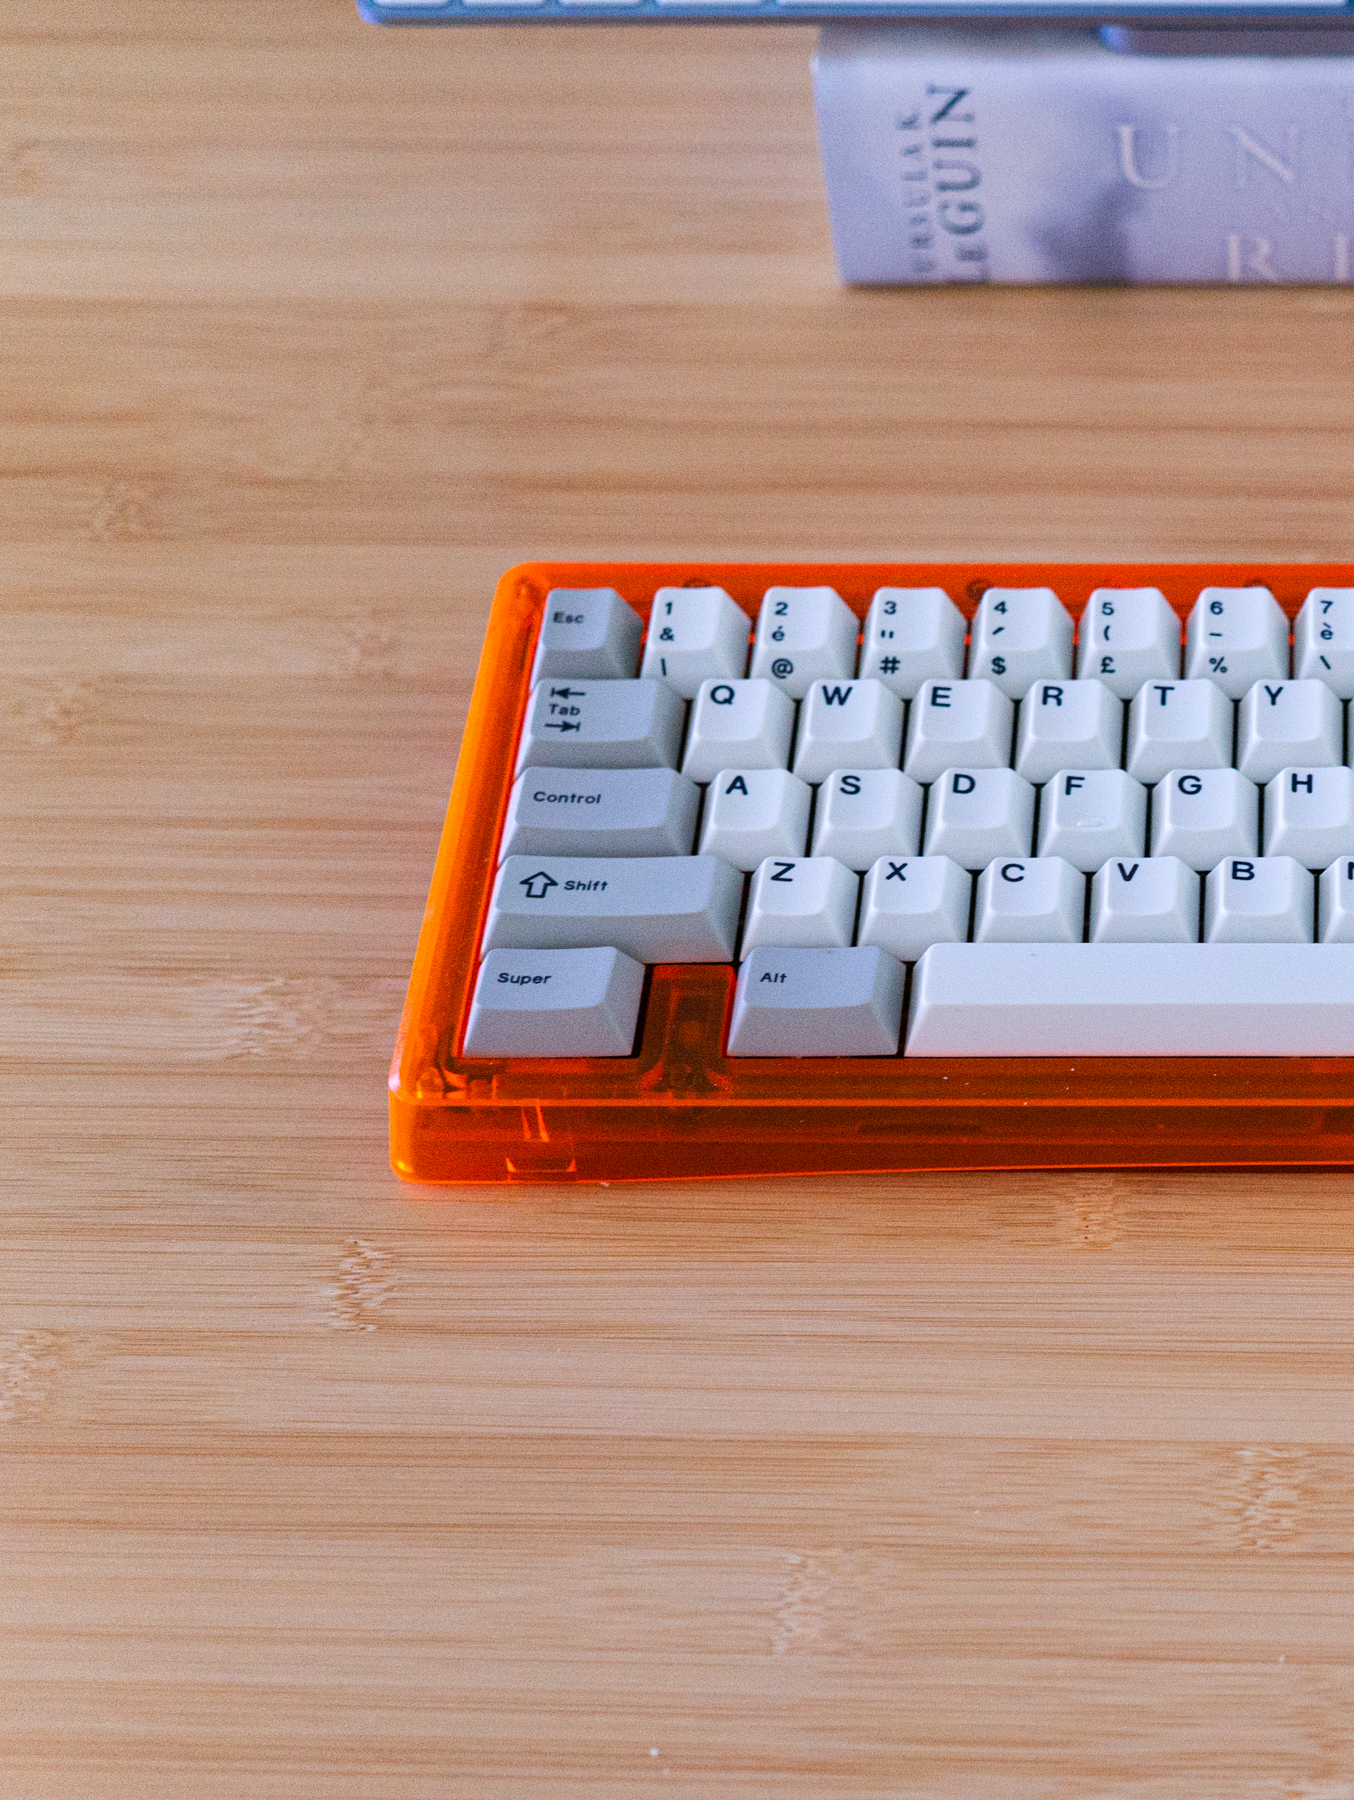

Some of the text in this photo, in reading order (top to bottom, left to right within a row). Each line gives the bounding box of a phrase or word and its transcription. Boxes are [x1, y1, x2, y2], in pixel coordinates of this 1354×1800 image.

[775, 602, 788, 616] 2
[884, 601, 897, 615] 3
[994, 601, 1007, 614] 4
[1102, 602, 1114, 616] 5
[1210, 601, 1223, 615] 6
[1321, 600, 1333, 614] 7
[553, 611, 583, 623] Esc
[659, 627, 674, 641] &
[771, 626, 785, 641] é
[1320, 623, 1333, 640] è
[771, 658, 794, 679] @
[880, 657, 900, 674] #
[992, 656, 1006, 675] $
[1101, 656, 1115, 674] £
[1209, 657, 1228, 673] %
[710, 685, 735, 705] Q
[822, 686, 852, 706] W
[931, 686, 951, 707] E
[1042, 686, 1063, 706] R
[1154, 686, 1174, 706] T
[1265, 685, 1283, 706] Y
[549, 703, 580, 716] Tab
[726, 776, 748, 795] A
[840, 775, 860, 795] S
[953, 774, 975, 794] D
[1065, 776, 1084, 795] F
[1178, 775, 1202, 795] G
[1291, 773, 1313, 793] H
[533, 791, 601, 804] Control
[771, 862, 795, 882] Z
[886, 862, 907, 881] X
[1001, 864, 1024, 882] C
[1118, 863, 1139, 881] V
[1232, 861, 1254, 880] B
[564, 880, 607, 890] Shift
[497, 972, 551, 985] Super
[760, 972, 786, 983] Alt
